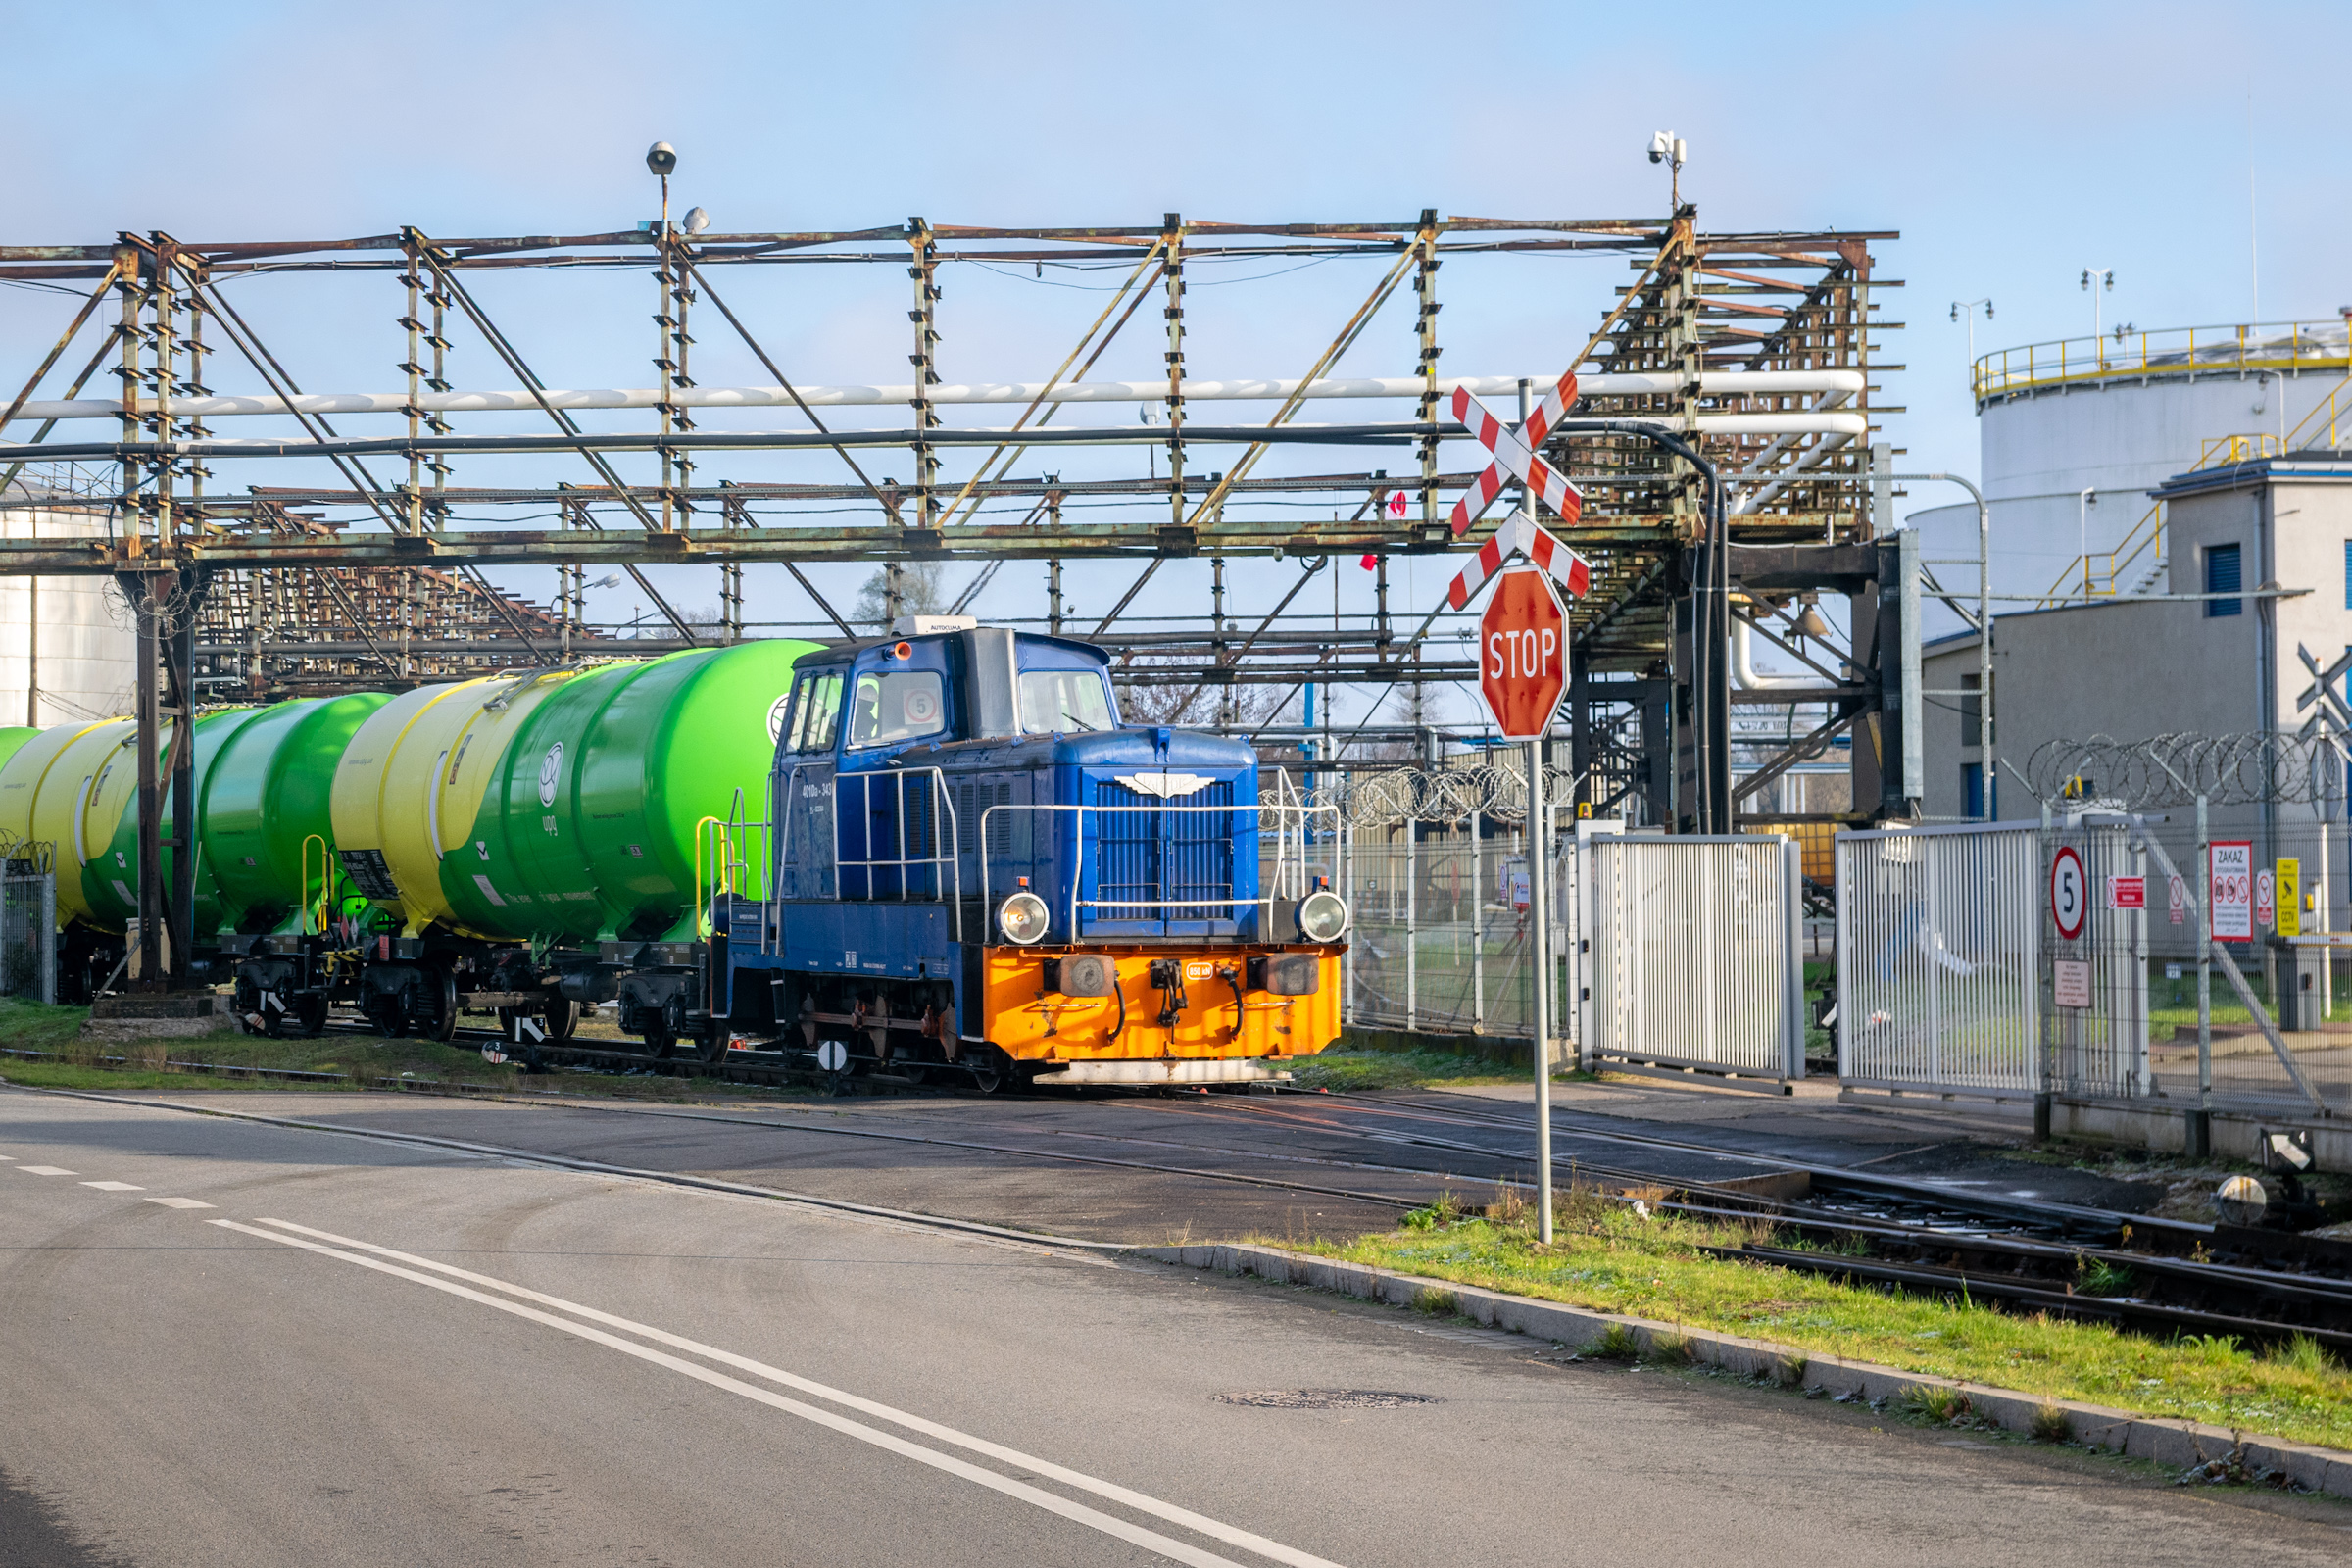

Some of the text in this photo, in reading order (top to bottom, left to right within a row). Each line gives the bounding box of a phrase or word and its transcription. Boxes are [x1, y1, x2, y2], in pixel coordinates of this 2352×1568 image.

[1489, 628, 1556, 679] STOP
[916, 698, 926, 714] 5
[542, 815, 558, 836] upg
[2218, 850, 2243, 863] ZAKAZ
[2063, 872, 2074, 913] 5
[2281, 910, 2294, 923] CCTV
[1189, 967, 1211, 976] 850 kN
